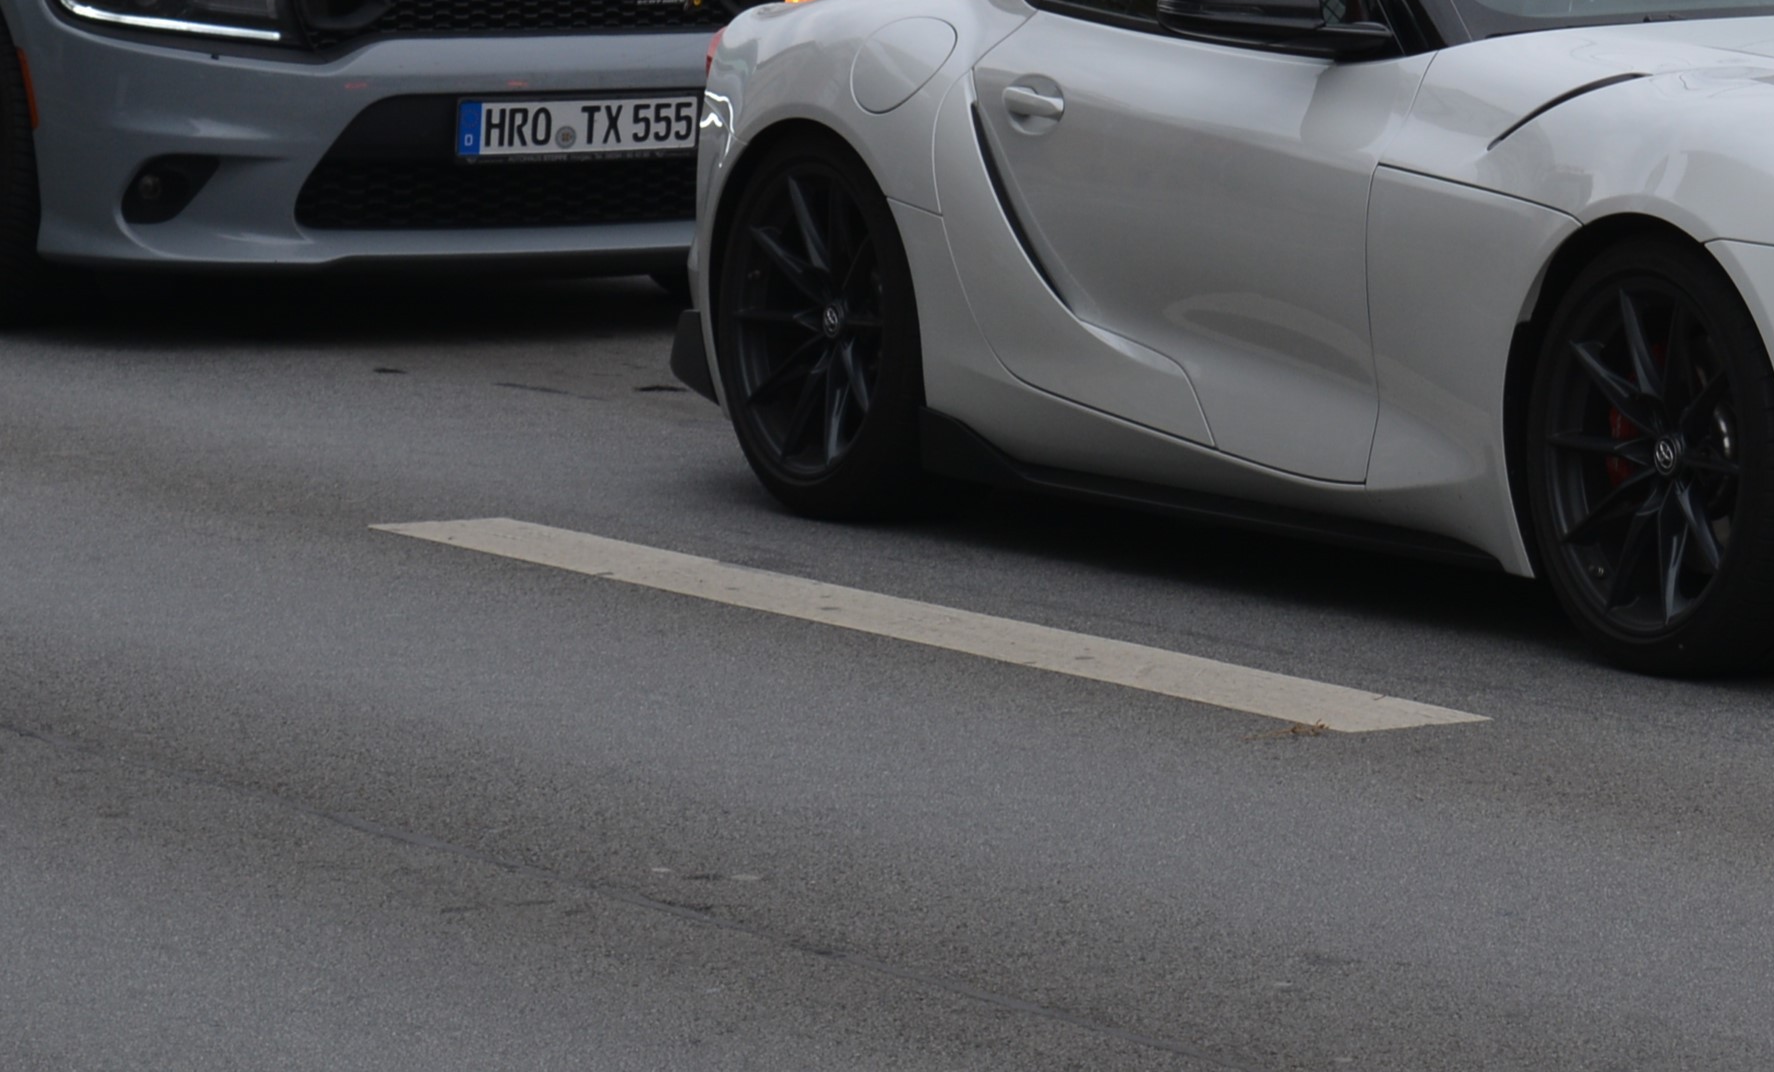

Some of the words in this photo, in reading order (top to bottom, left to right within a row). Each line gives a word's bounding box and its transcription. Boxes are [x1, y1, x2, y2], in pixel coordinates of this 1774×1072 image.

[484, 106, 551, 148] HRO
[581, 104, 623, 145] TX
[632, 101, 693, 142] 555
[464, 134, 473, 146] D
